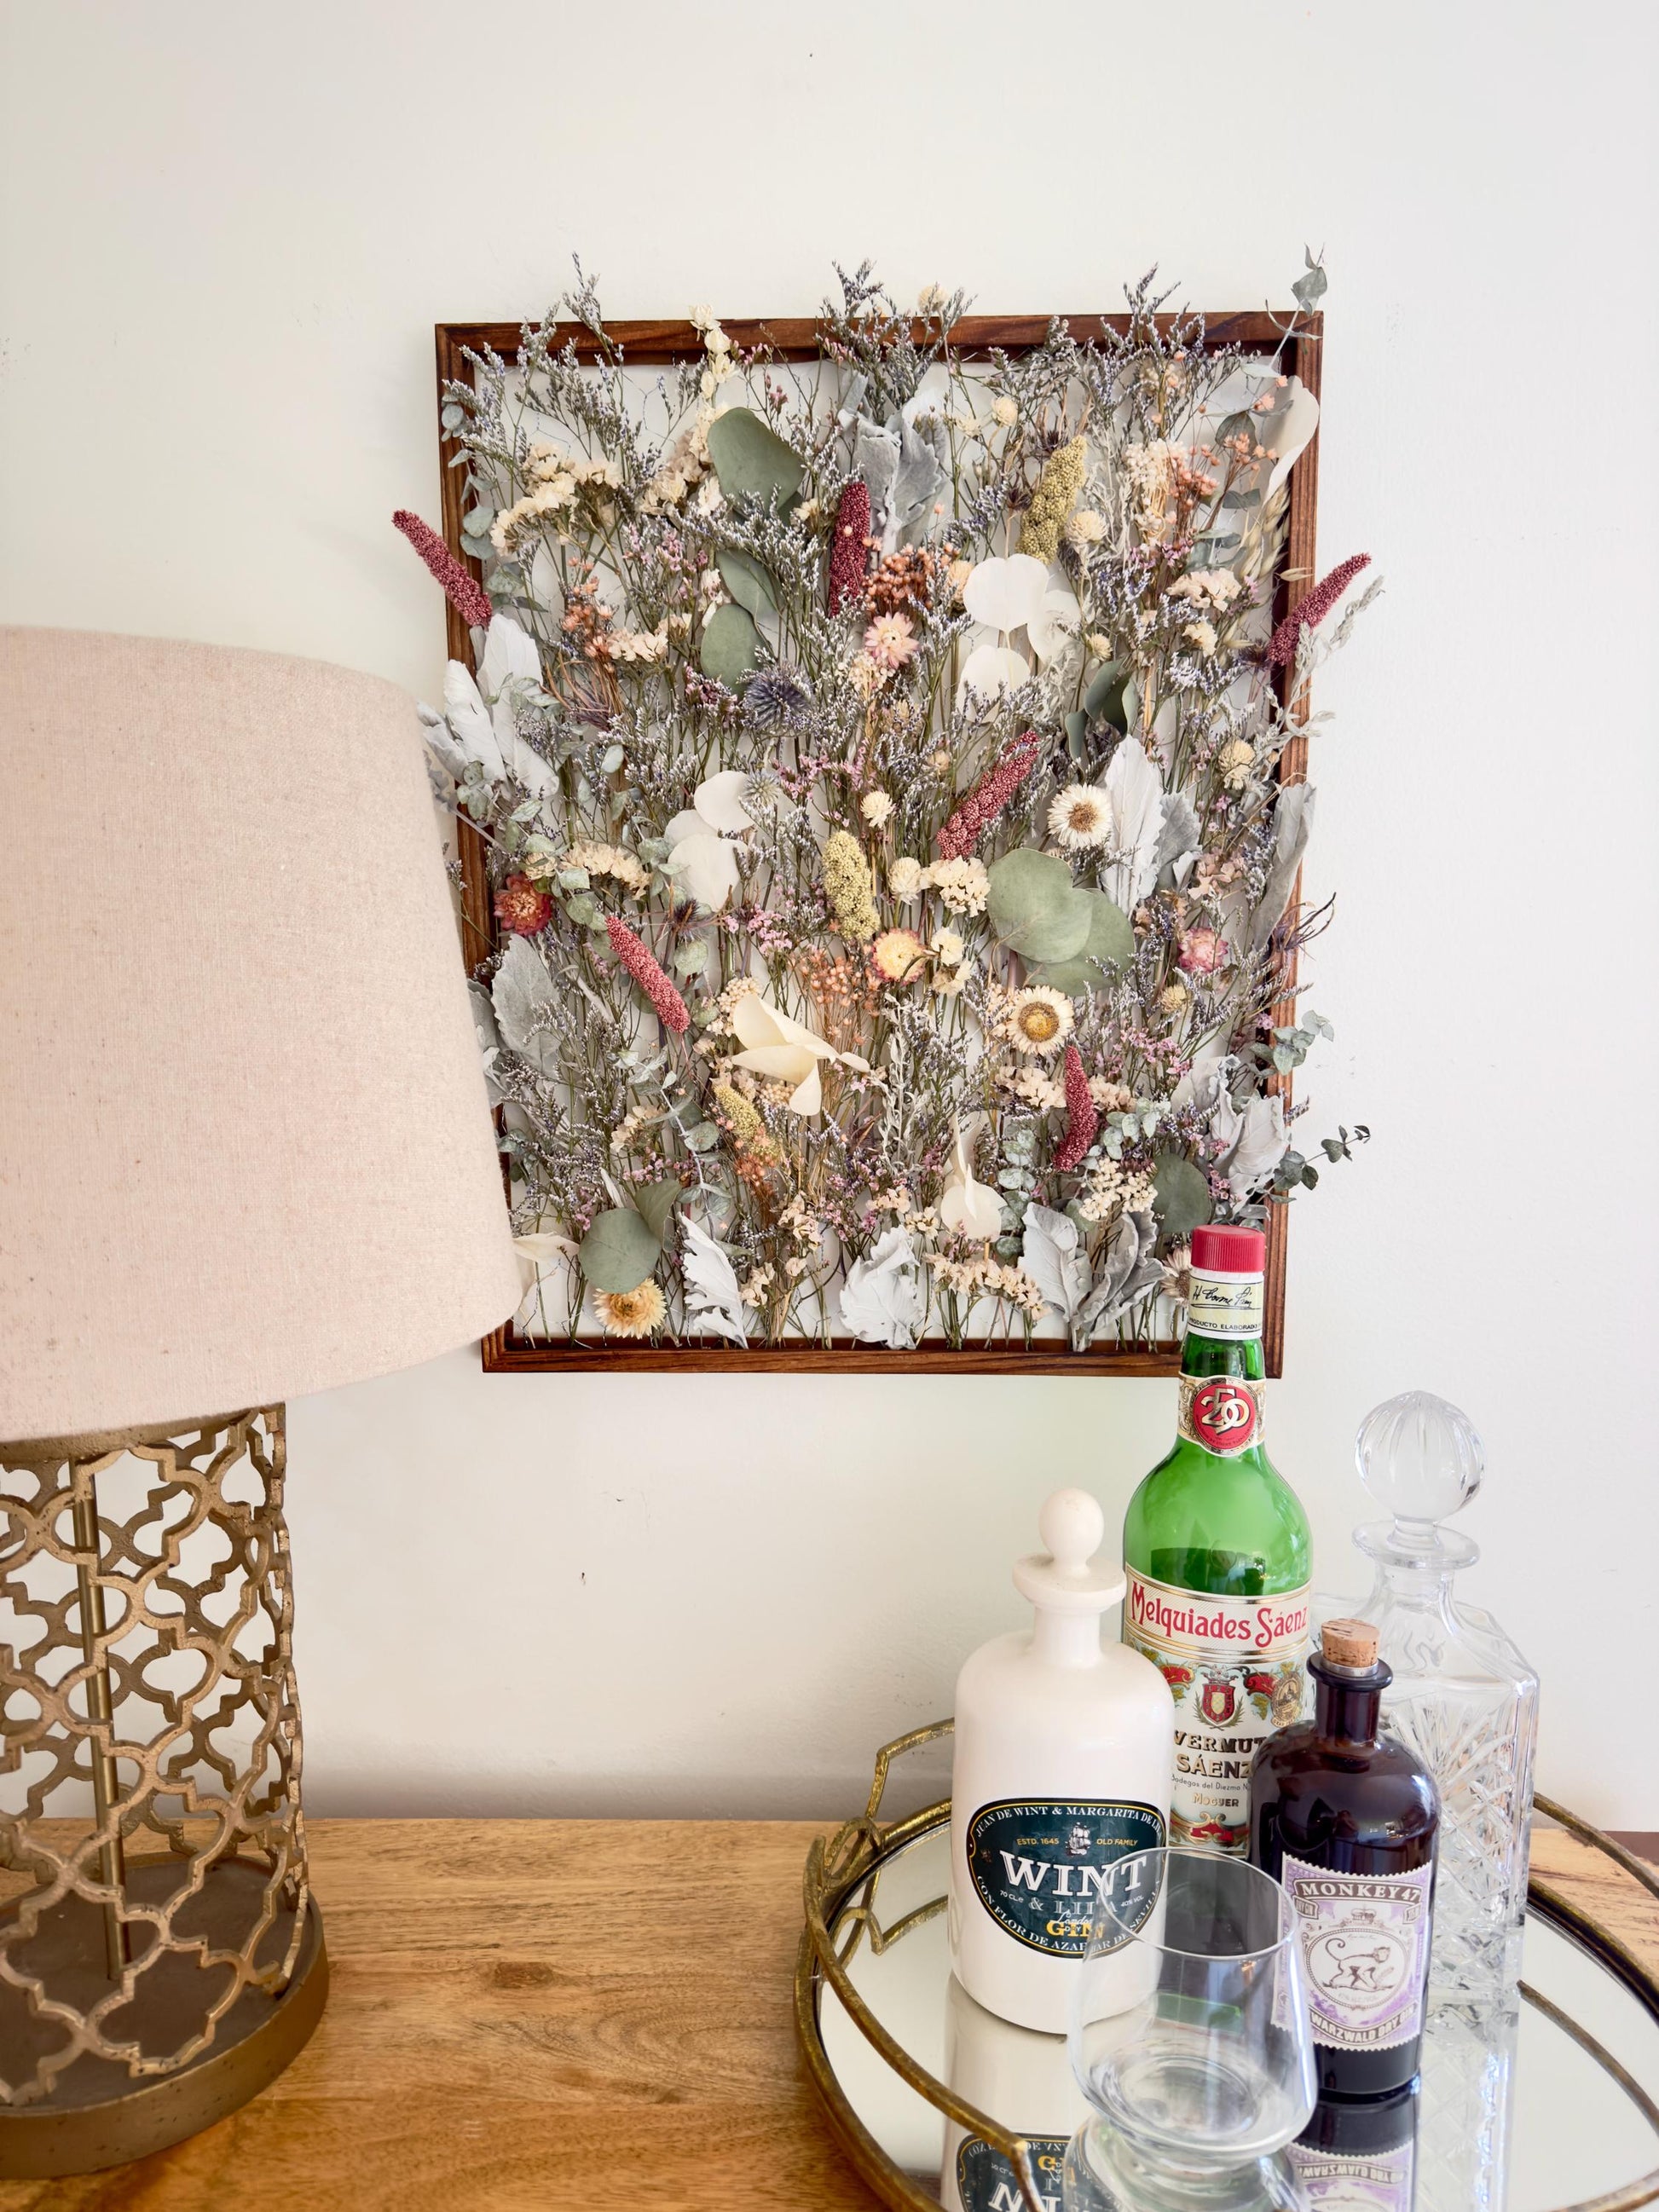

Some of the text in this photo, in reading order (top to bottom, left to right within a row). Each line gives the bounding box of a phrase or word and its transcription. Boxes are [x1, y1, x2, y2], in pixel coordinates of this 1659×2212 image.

[1200, 1388, 1251, 1435] 250
[1131, 1580, 1309, 1649] Melquiades Sáenz
[1176, 1753, 1252, 1779] SÁENZ
[1216, 1782, 1241, 1791] Diezmo
[975, 1813, 996, 1838] JUAN
[996, 1809, 1013, 1821] DE
[1013, 1806, 1049, 1816] WINT
[1051, 1806, 1063, 1815] &
[1066, 1806, 1139, 1821] MARGARITA
[1141, 1812, 1153, 1825] DE
[999, 1850, 1147, 1897] WINT
[1028, 1897, 1044, 1911] &
[1300, 1882, 1421, 1903] MONKEY 47
[977, 1875, 995, 1904] CON
[994, 1905, 1026, 1936] FLOR
[1029, 1932, 1049, 1946] DE
[1056, 1909, 1094, 1925] Londo
[1311, 2011, 1377, 2042] WARZWALD
[1377, 2018, 1401, 2038] DRY
